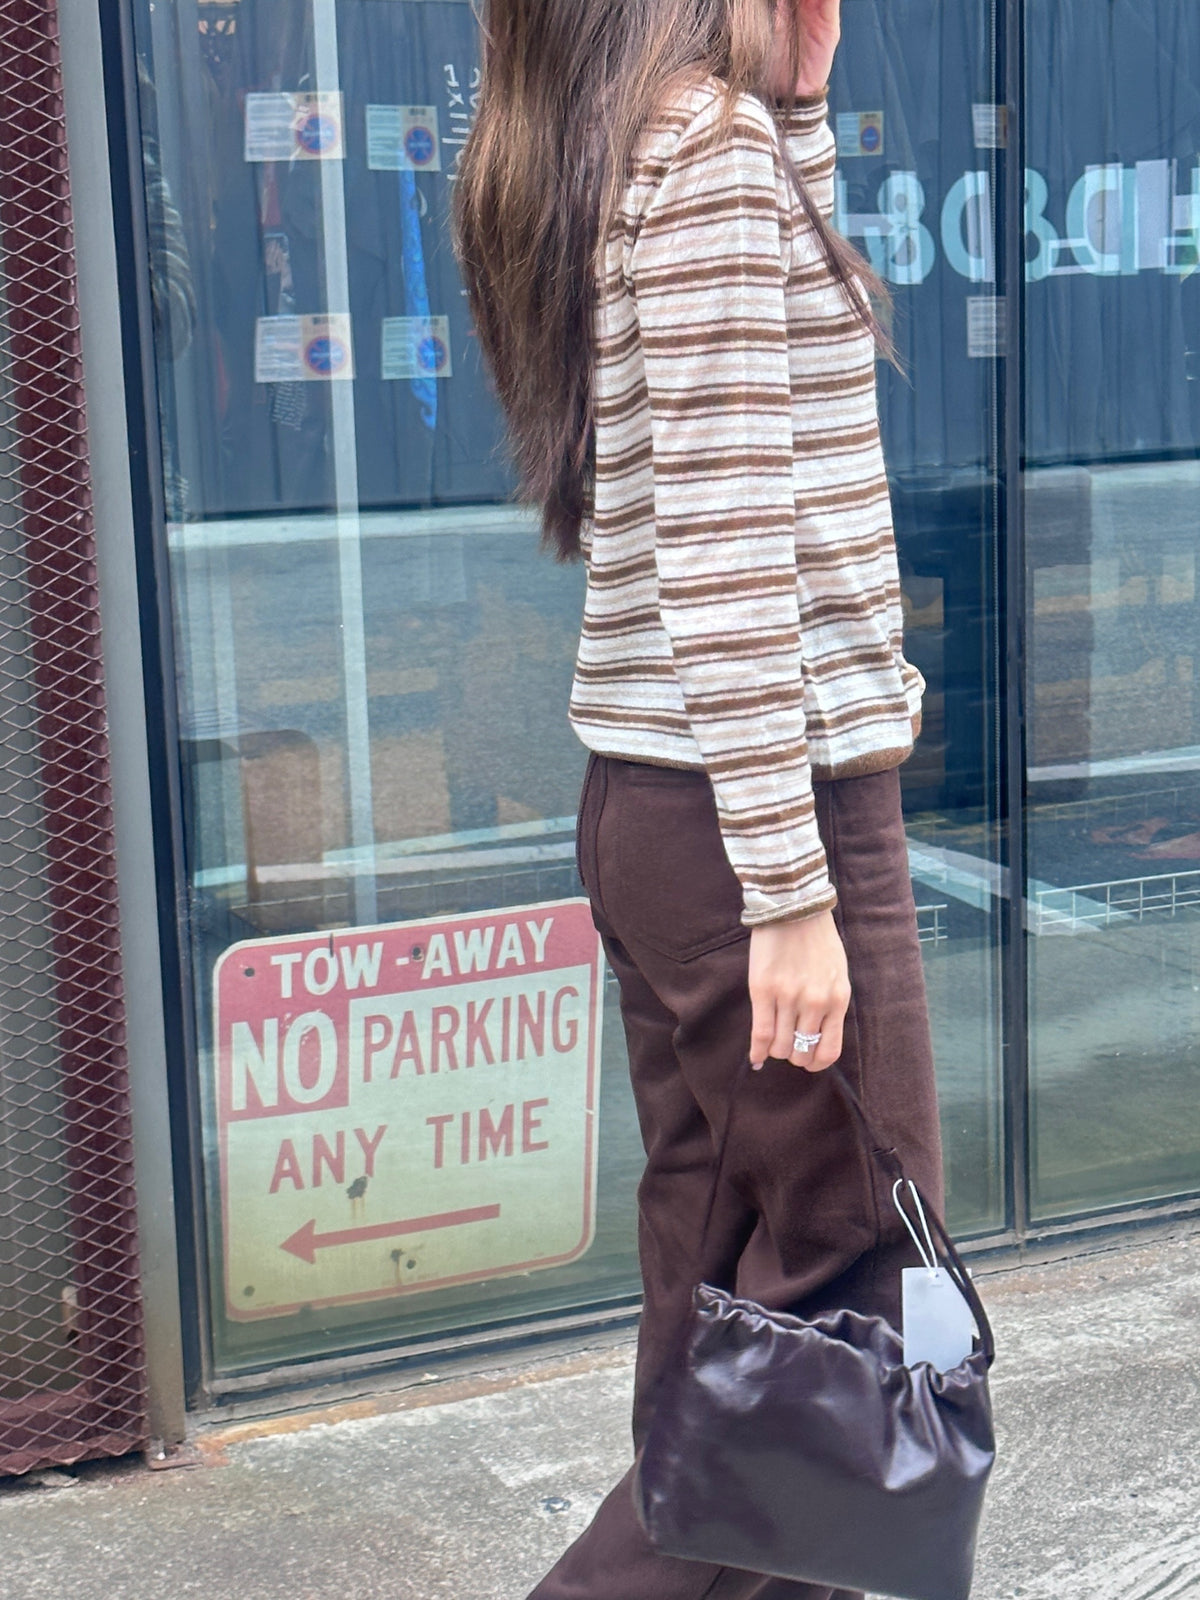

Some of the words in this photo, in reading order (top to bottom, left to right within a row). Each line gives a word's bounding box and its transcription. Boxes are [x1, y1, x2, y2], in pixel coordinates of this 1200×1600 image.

[231, 1010, 338, 1111] NO
[363, 986, 580, 1083] PARKING
[269, 1124, 388, 1194] ANY
[426, 1097, 550, 1169] TIME
